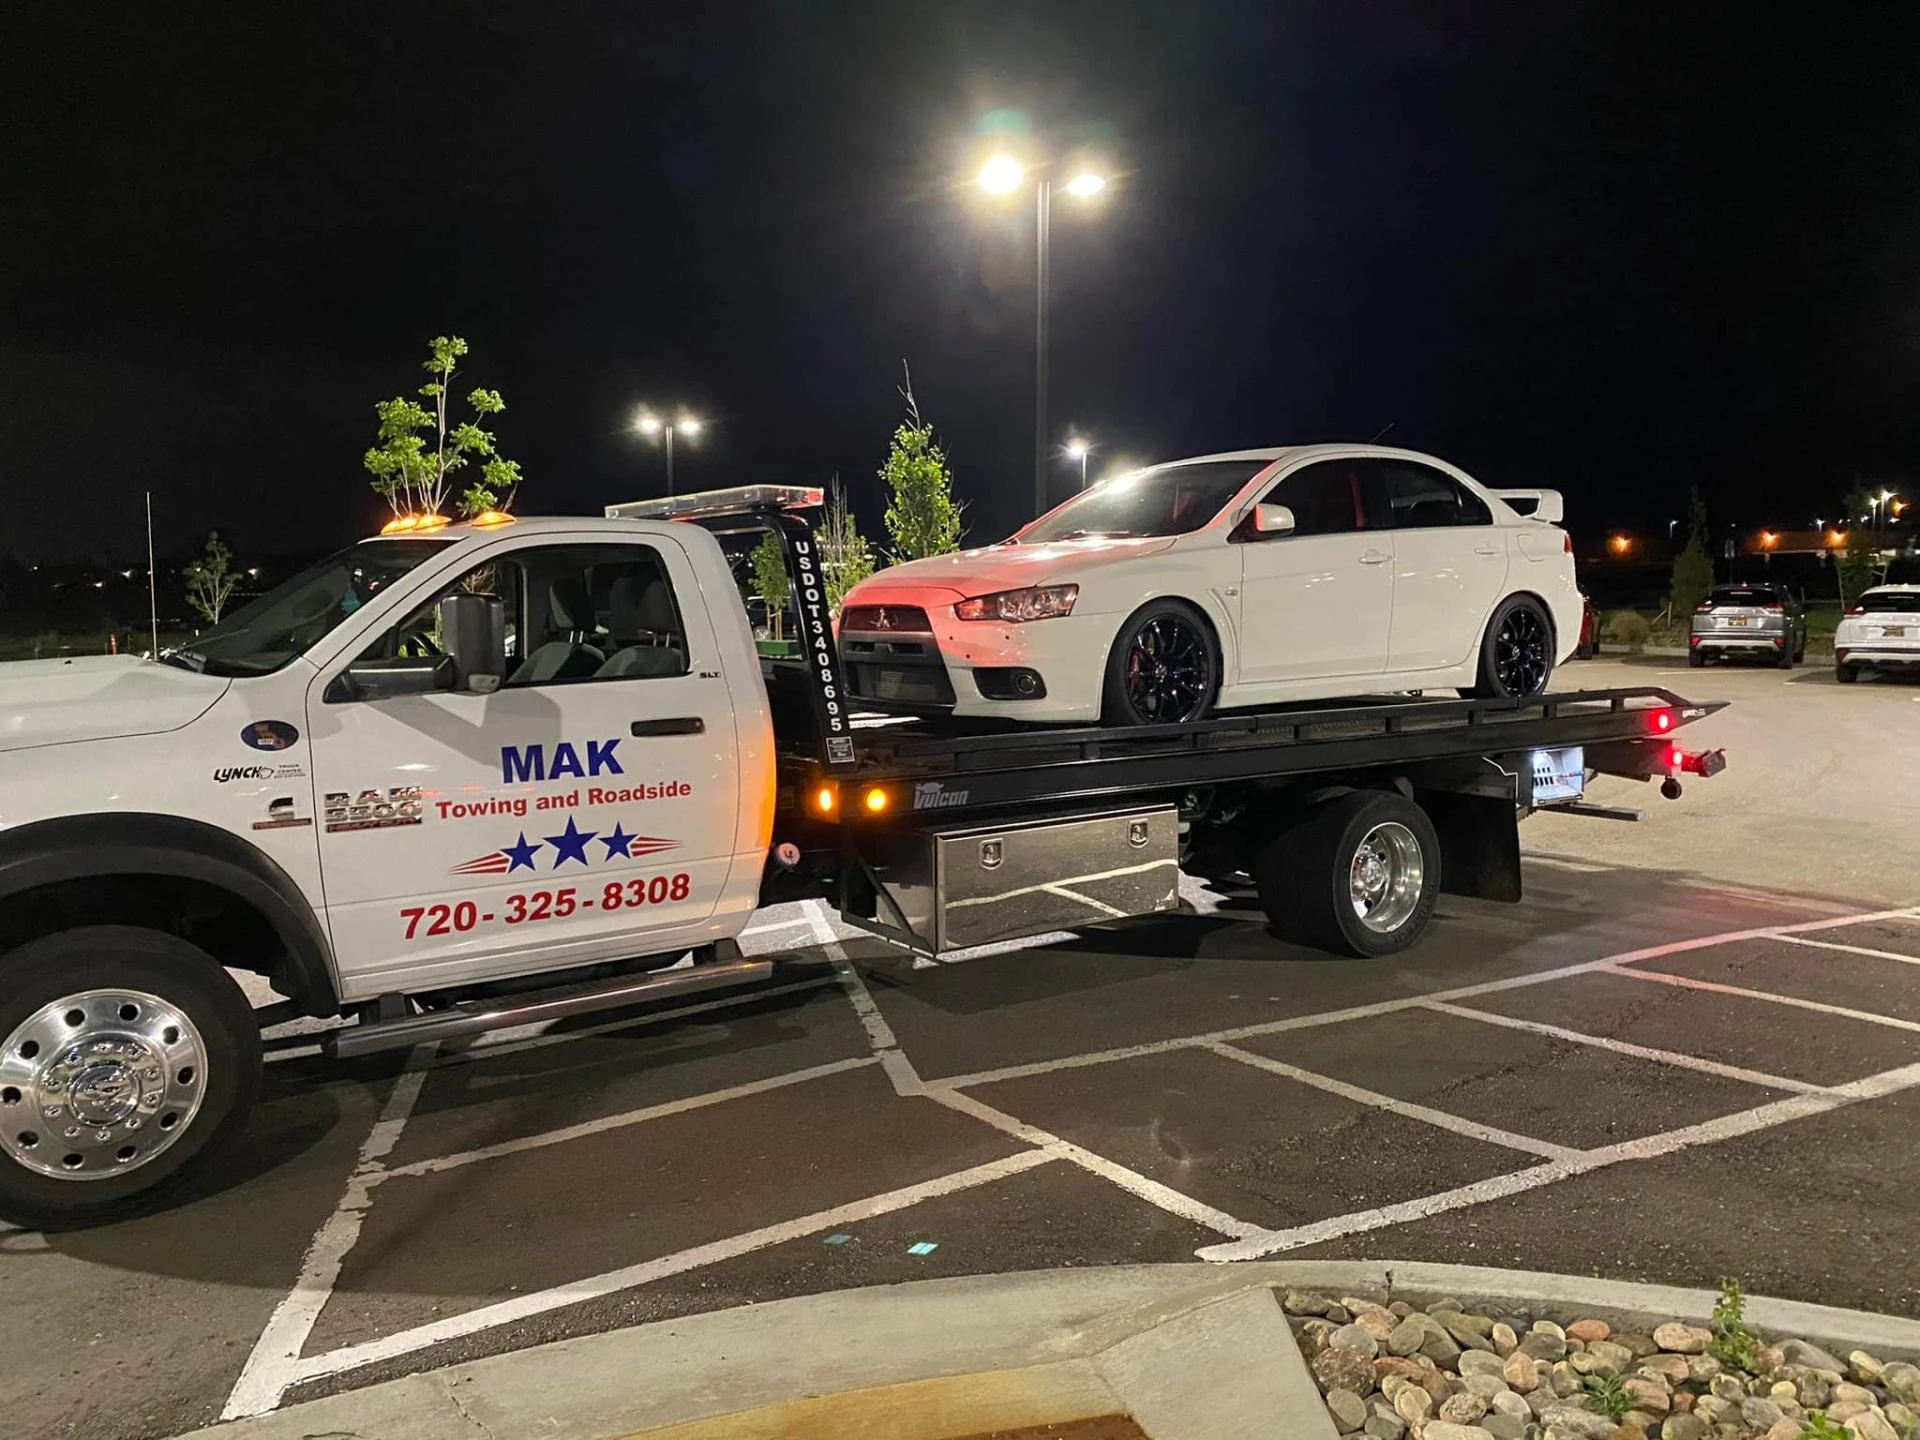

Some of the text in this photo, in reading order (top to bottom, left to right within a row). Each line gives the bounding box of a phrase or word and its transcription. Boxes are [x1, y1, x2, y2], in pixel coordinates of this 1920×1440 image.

[213, 766, 262, 783] LYNCH
[501, 738, 624, 784] MAK
[435, 780, 691, 819] Towing and Roadside
